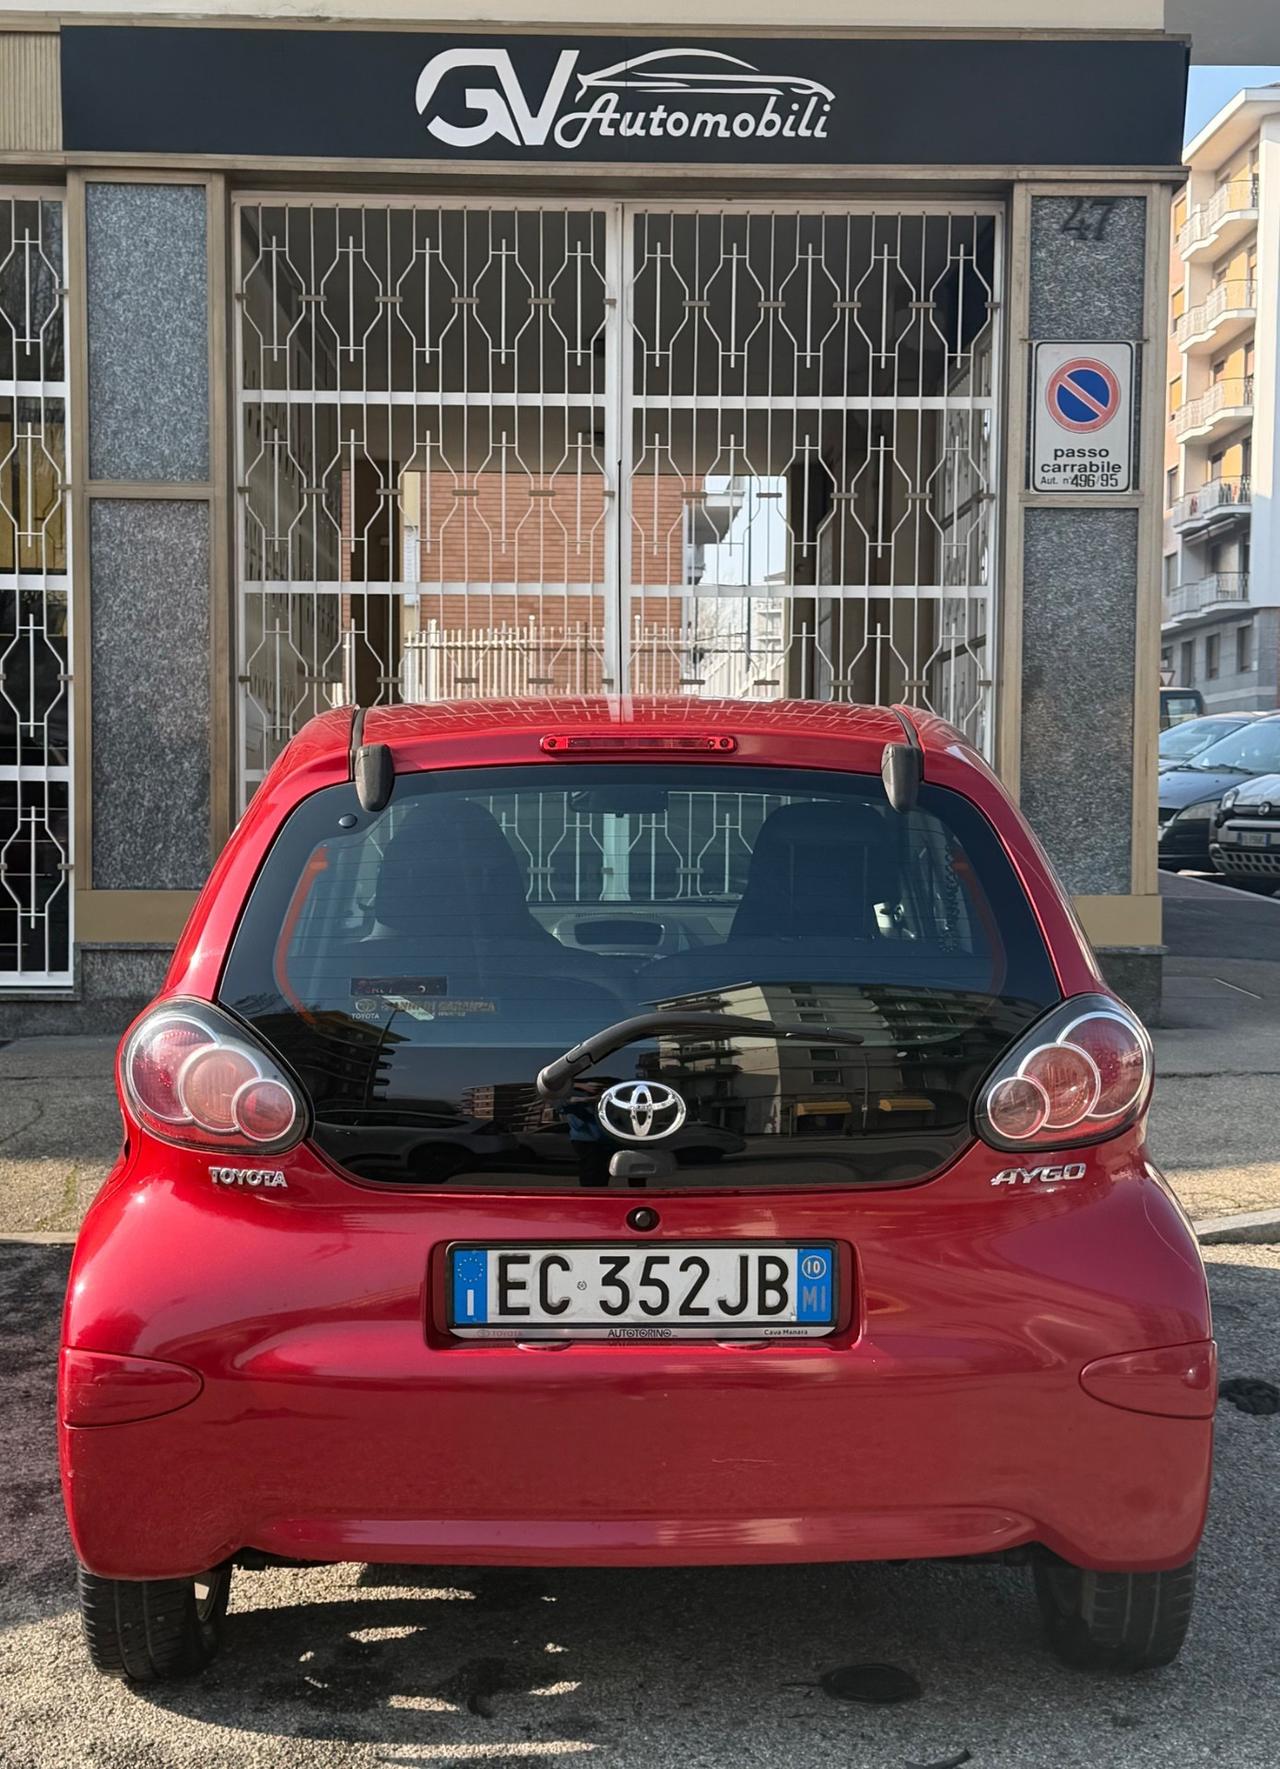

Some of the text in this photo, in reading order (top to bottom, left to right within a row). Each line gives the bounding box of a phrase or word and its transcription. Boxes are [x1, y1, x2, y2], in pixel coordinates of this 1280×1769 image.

[415, 48, 831, 149] GV Automobili
[1061, 197, 1116, 241] 47
[1053, 448, 1110, 461] passo
[1040, 461, 1122, 473] carrabile
[1040, 476, 1058, 485] Aut.
[351, 1012, 380, 1020] TOYOTA
[208, 1166, 288, 1188] TOYOTA
[990, 1163, 1087, 1186] AYGO
[807, 1260, 821, 1275] 10
[498, 1255, 571, 1316] EC
[802, 1286, 827, 1312] MI
[608, 1328, 672, 1338] AUTOTORINO
[764, 1328, 782, 1336] Cava
